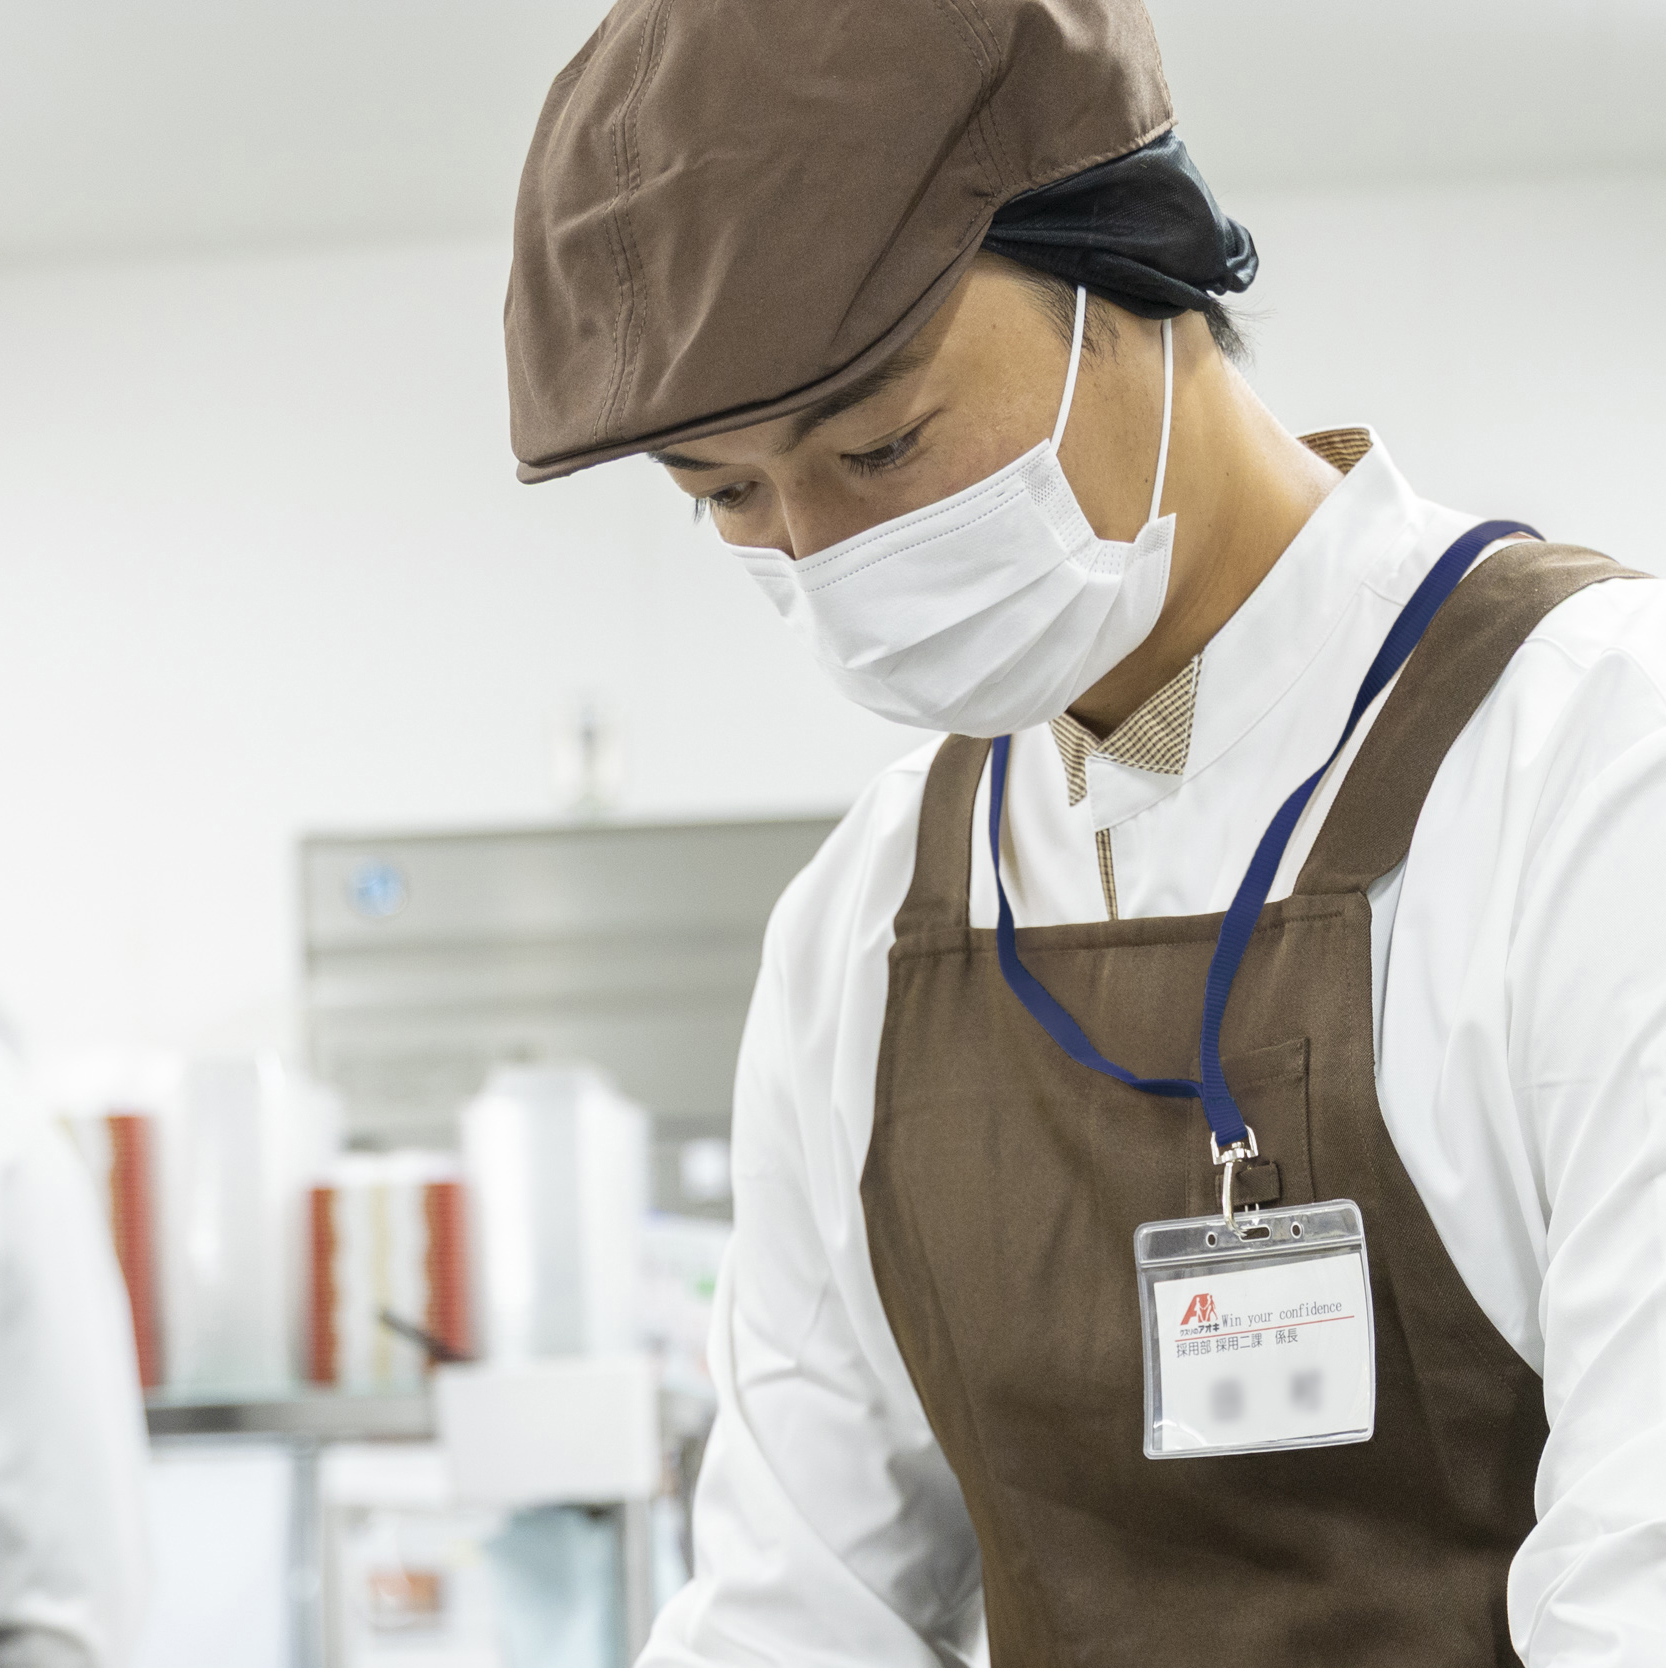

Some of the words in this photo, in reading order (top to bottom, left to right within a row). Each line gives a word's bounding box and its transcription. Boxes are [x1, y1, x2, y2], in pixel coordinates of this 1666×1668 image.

[1222, 1313, 1242, 1327] Win
[1248, 1312, 1273, 1327] your
[1279, 1301, 1343, 1320] confidence
[1176, 1340, 1211, 1358] 採用部
[1216, 1332, 1263, 1352] 採用二課
[1275, 1328, 1298, 1344] 係長
